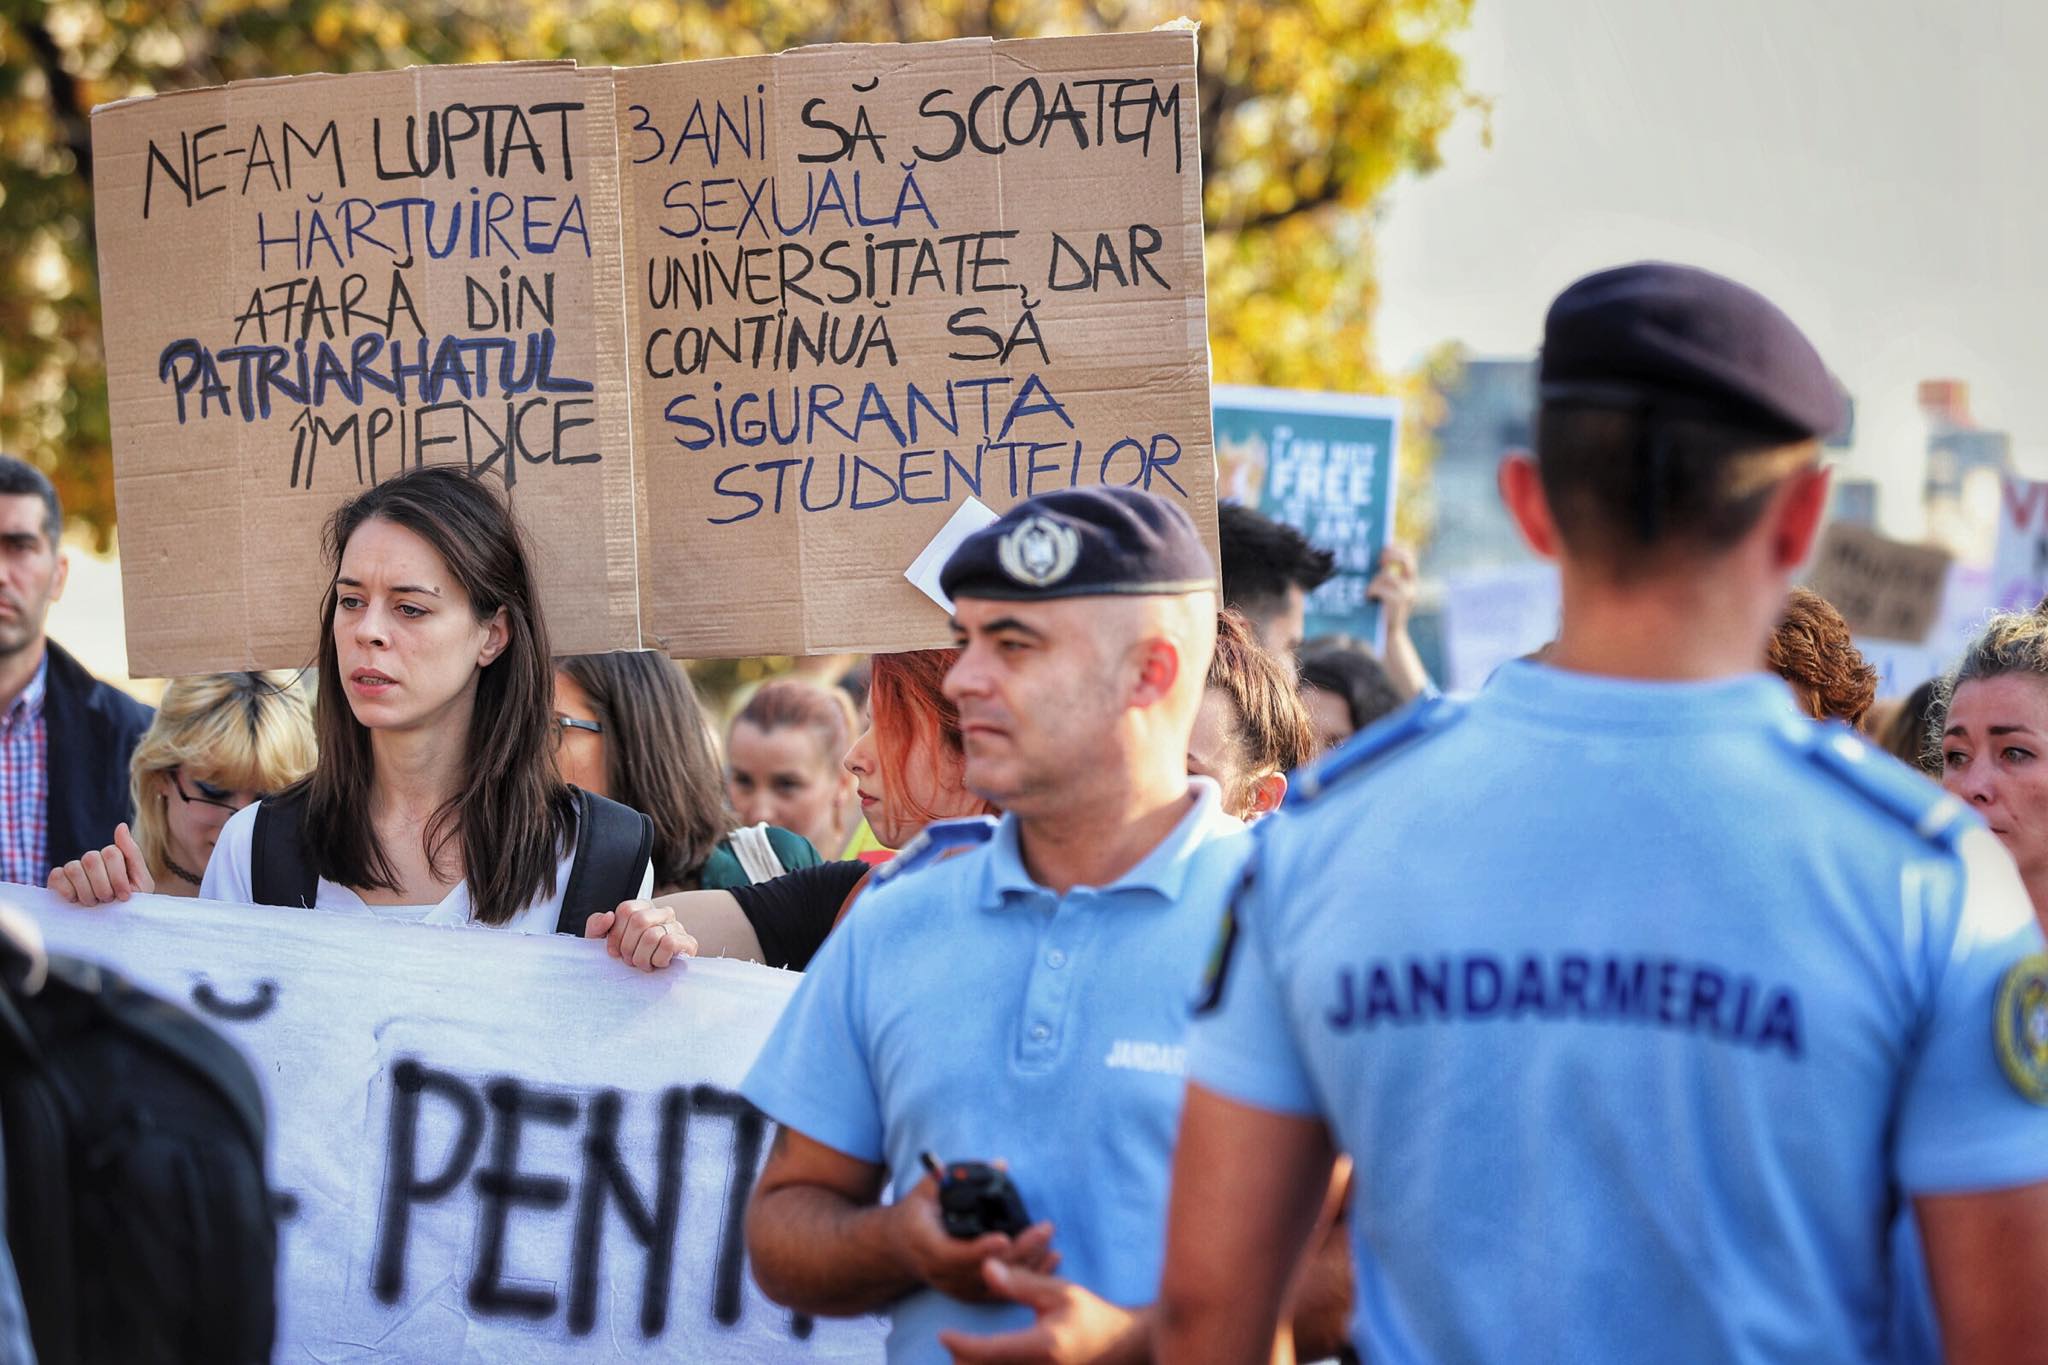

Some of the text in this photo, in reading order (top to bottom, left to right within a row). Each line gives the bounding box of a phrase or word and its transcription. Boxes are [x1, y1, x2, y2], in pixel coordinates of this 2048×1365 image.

[144, 120, 347, 218] NE-AM
[374, 102, 585, 180] LUPTAT
[797, 76, 887, 164] SĂ
[912, 77, 1181, 173] SCOATEM
[659, 159, 938, 240] SEXUALĂ
[1048, 223, 1171, 293] DAR
[946, 298, 1051, 366] SĂ
[1270, 459, 1375, 506] FREE
[1324, 950, 1807, 1062] JANDARMERIA
[1104, 1040, 1185, 1075] JANDAR
[370, 1056, 813, 1340] PENT
